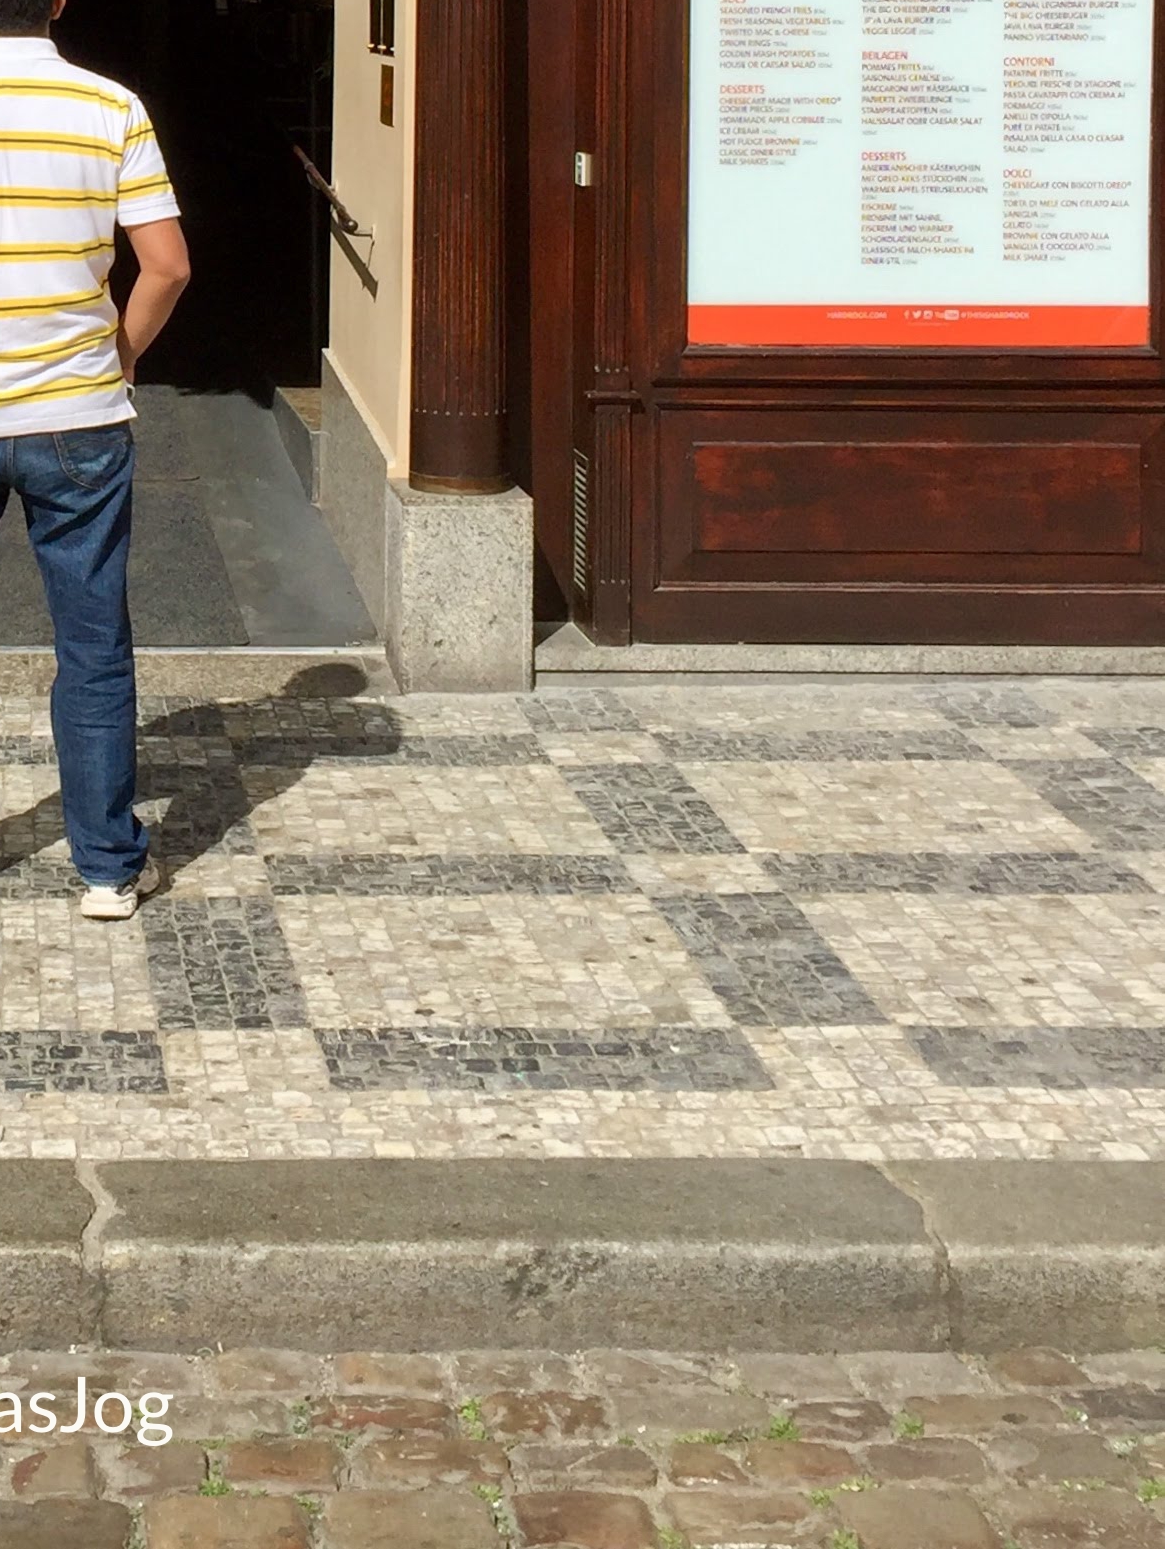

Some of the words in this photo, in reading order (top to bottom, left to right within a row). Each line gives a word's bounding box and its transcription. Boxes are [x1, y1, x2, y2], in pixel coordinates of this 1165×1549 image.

[1004, 58, 1054, 66] CONTORNI
[720, 85, 765, 94] DESSERTS
[861, 152, 906, 161] DESSERTS
[1003, 169, 1031, 178] DOLCI
